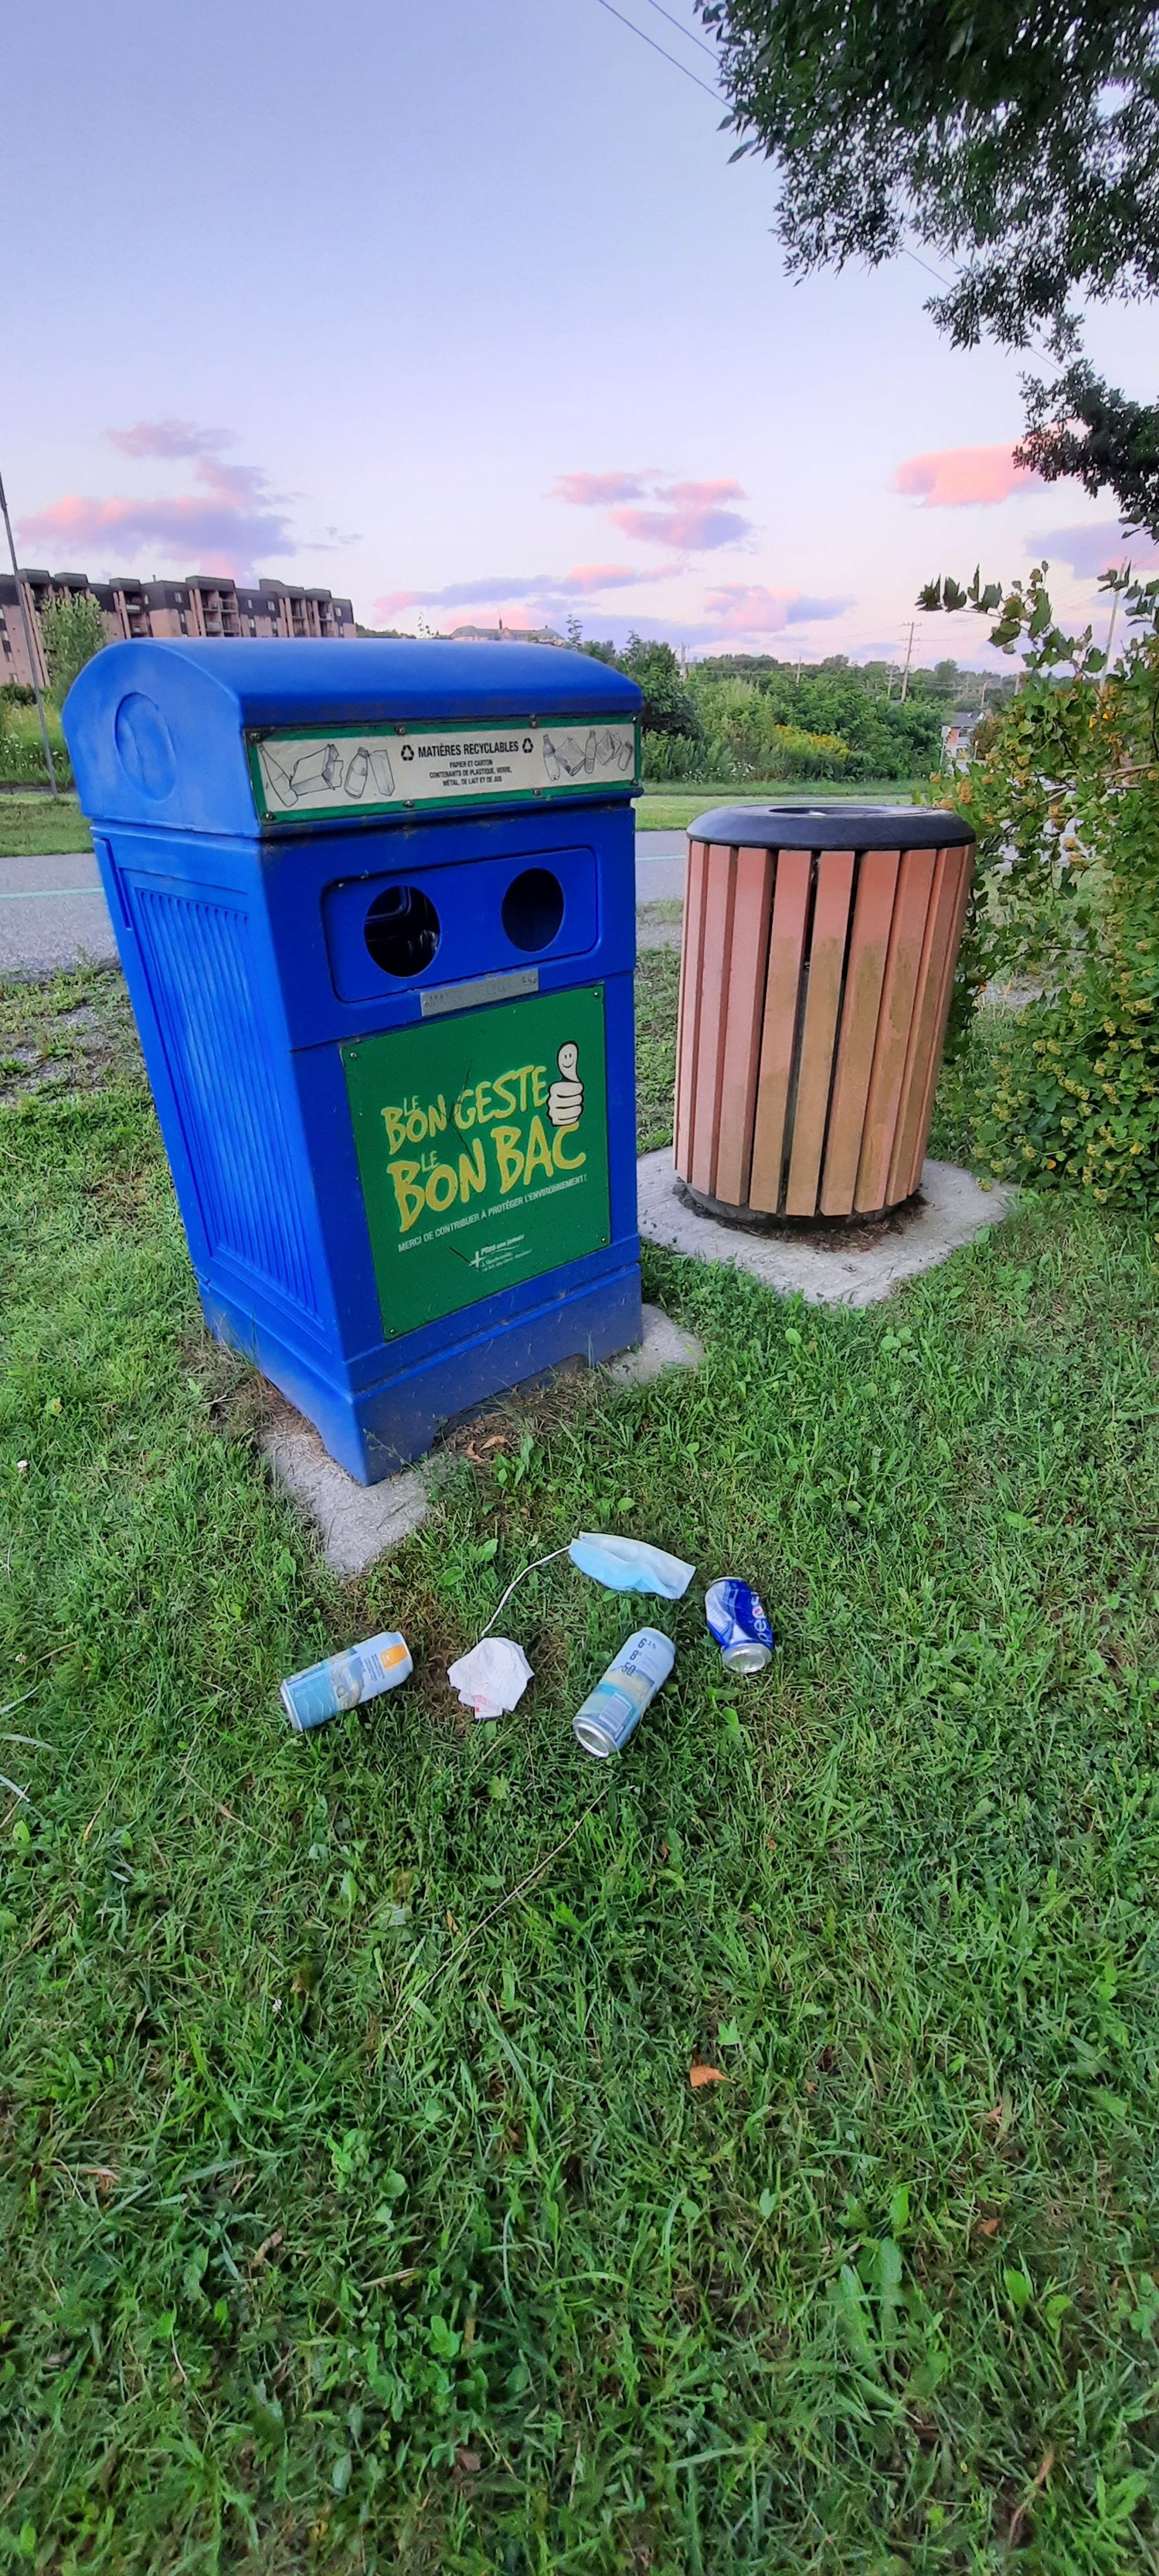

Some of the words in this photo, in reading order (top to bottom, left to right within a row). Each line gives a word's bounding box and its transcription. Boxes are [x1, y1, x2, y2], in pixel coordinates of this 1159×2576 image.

[419, 743, 461, 757] MATIÈRES
[464, 740, 519, 754] RECYCLABLES
[430, 770, 462, 778] CONTENANTS
[380, 1094, 447, 1155] BON
[454, 1065, 549, 1130] GESTE
[403, 1094, 421, 1116] LE
[420, 1150, 440, 1172] LE
[386, 1138, 487, 1233] BON
[491, 1115, 586, 1194] BAC
[399, 1237, 422, 1252] MERCI
[423, 1232, 434, 1242] DE
[435, 1213, 480, 1237] CONTRIBUER
[481, 1210, 487, 1220] À
[488, 1196, 523, 1217] PROTÉGER
[621, 1662, 637, 1676] 50
